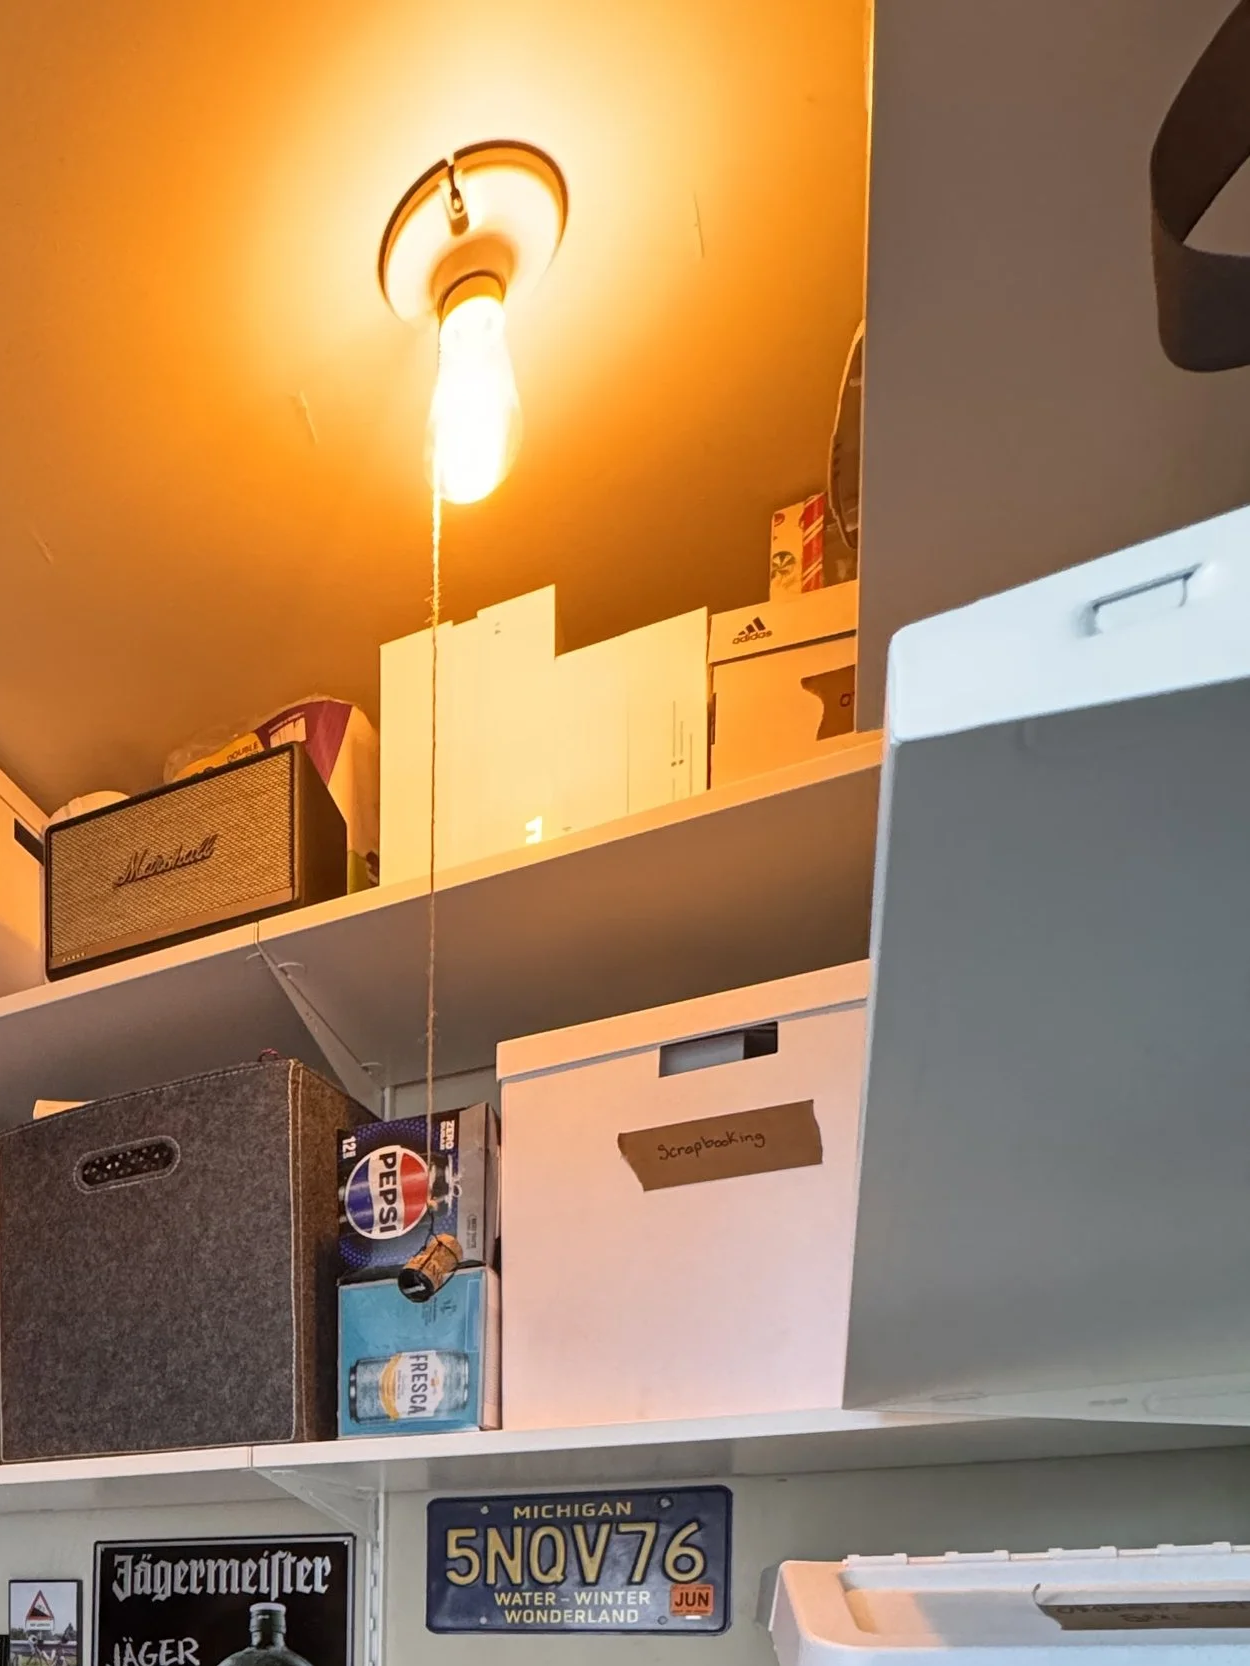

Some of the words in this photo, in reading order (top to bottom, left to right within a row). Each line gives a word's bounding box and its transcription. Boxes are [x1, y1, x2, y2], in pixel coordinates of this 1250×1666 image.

[732, 629, 773, 645] adidas
[113, 833, 219, 889] Marshall
[445, 1120, 455, 1149] ZERO
[379, 1152, 398, 1233] PEPSI
[408, 1355, 429, 1416] FRESCA
[513, 1501, 632, 1520] MICHIGAN
[446, 1522, 705, 1585] 5NQV76
[494, 1591, 556, 1607] WATER
[574, 1590, 650, 1606] WINTER
[674, 1591, 709, 1607] JUN
[504, 1609, 639, 1624] WONDERLAND
